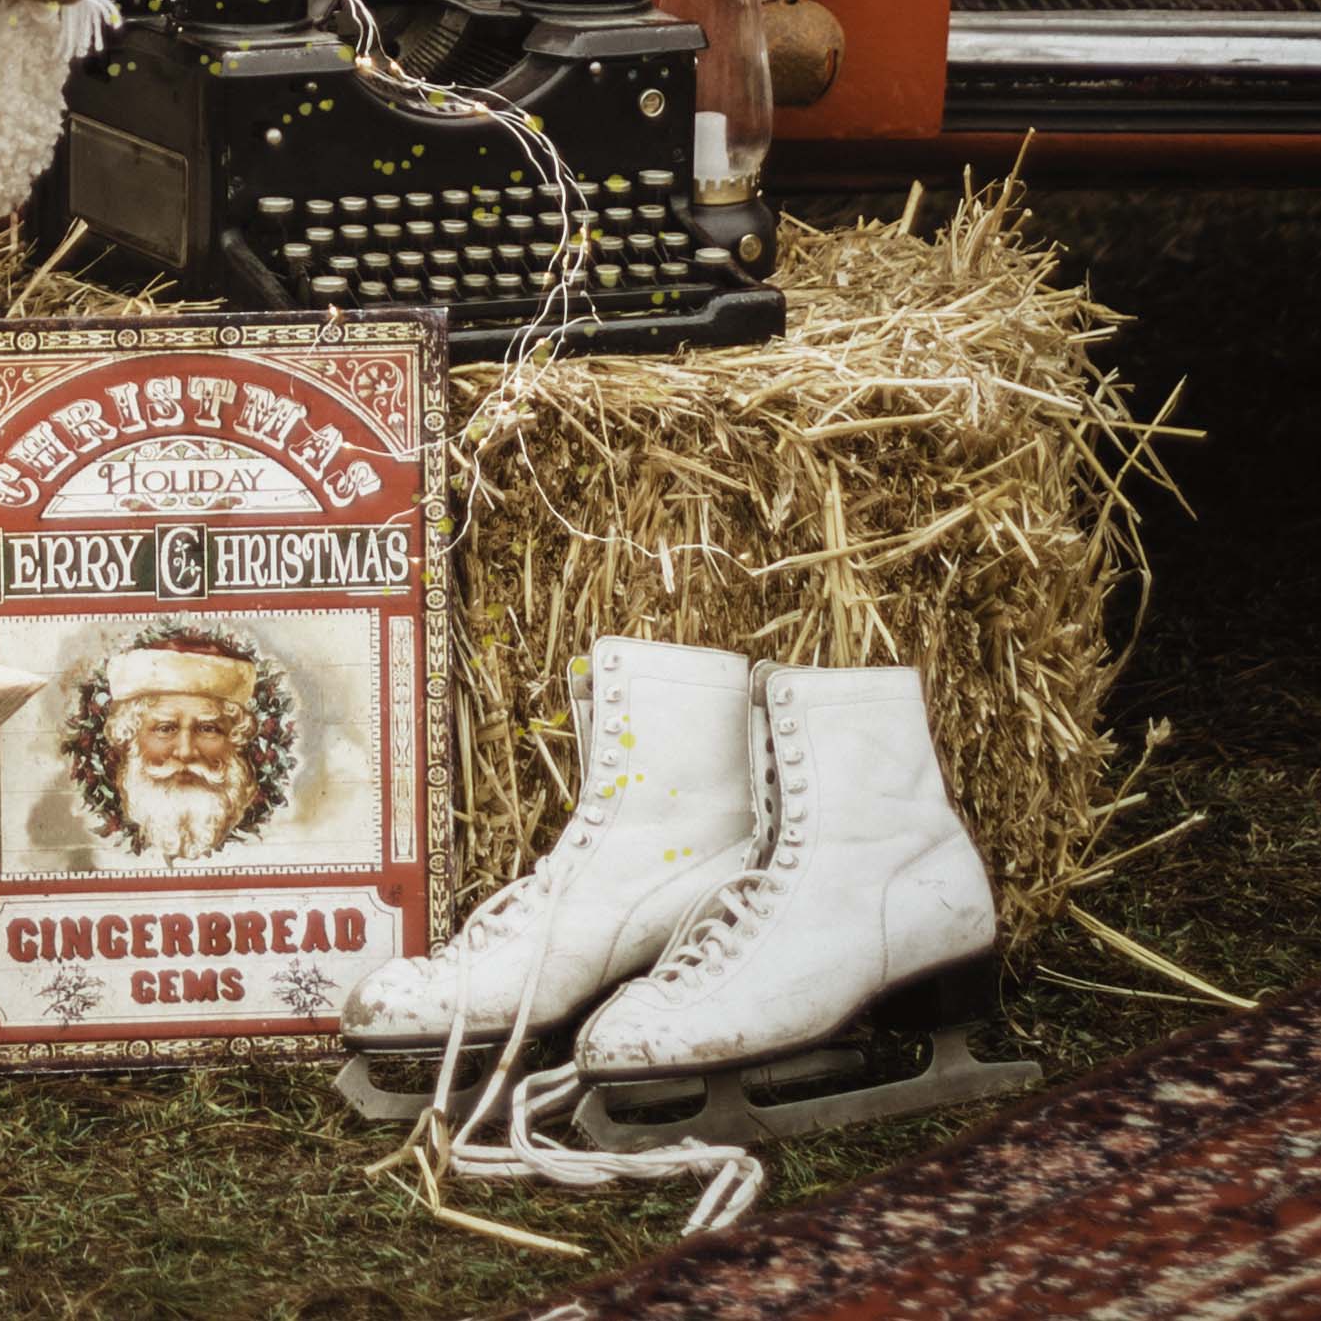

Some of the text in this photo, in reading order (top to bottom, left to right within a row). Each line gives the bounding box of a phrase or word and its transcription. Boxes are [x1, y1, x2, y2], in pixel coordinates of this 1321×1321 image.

[101, 461, 268, 497] HOLIDAY
[157, 525, 413, 599] CHRISTMAS
[5, 907, 368, 963] GINGERBREAD
[129, 966, 246, 1005] GEMS
